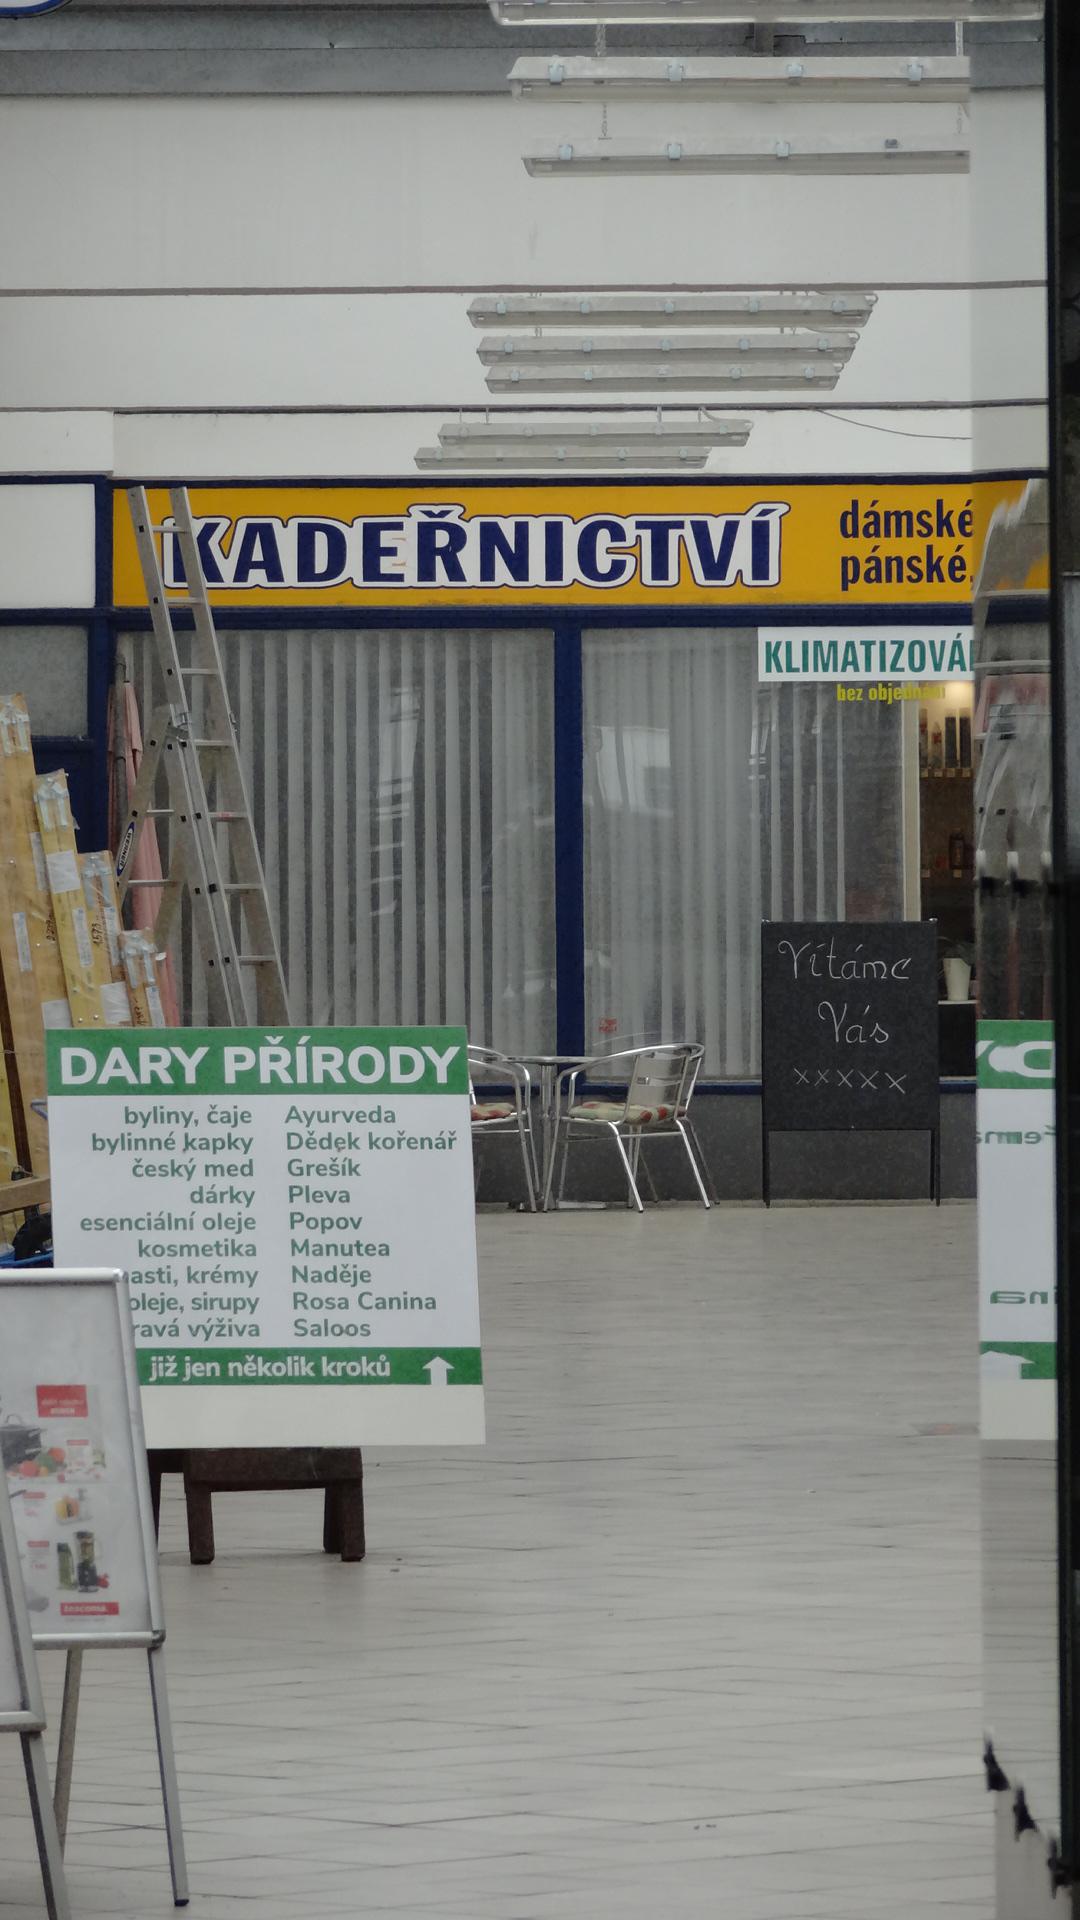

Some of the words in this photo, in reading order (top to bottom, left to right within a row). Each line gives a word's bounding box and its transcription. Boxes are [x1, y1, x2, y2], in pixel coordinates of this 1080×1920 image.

[172, 507, 779, 584] KADEŘNICTVÍ
[837, 684, 863, 701] bez
[778, 936, 912, 980] Vítáme
[817, 1000, 890, 1044] Vás
[61, 1047, 209, 1084] DARY
[224, 1036, 460, 1083] PŘÍRODY
[125, 1106, 198, 1128] byliny,
[207, 1105, 251, 1128] čaje
[285, 1105, 395, 1127] Ayurveda
[92, 1132, 175, 1154] bylinné
[185, 1133, 253, 1154] kapky
[287, 1131, 360, 1152] Dědek
[369, 1131, 456, 1150] kořenář
[132, 1158, 196, 1181] český
[205, 1159, 253, 1177] med
[288, 1157, 360, 1176] Grešík
[191, 1184, 255, 1207] dárky
[289, 1185, 350, 1203] Pleva
[80, 1211, 195, 1231] esenciální
[203, 1212, 256, 1234] oleje
[290, 1212, 362, 1234] Popov
[139, 1239, 256, 1257] kosmetika
[291, 1239, 389, 1256] Manutea
[131, 1265, 179, 1287] asti,
[187, 1264, 258, 1288] krémy
[292, 1264, 371, 1287] Naděje
[192, 1292, 259, 1314] sirupy
[293, 1292, 349, 1310] Rosa
[358, 1292, 436, 1310] Canina
[188, 1318, 259, 1341] výživa
[294, 1319, 371, 1336] Saloos
[148, 1354, 179, 1382] již
[181, 1354, 221, 1383] jen
[227, 1353, 316, 1380] několik
[321, 1352, 392, 1380] kroků
